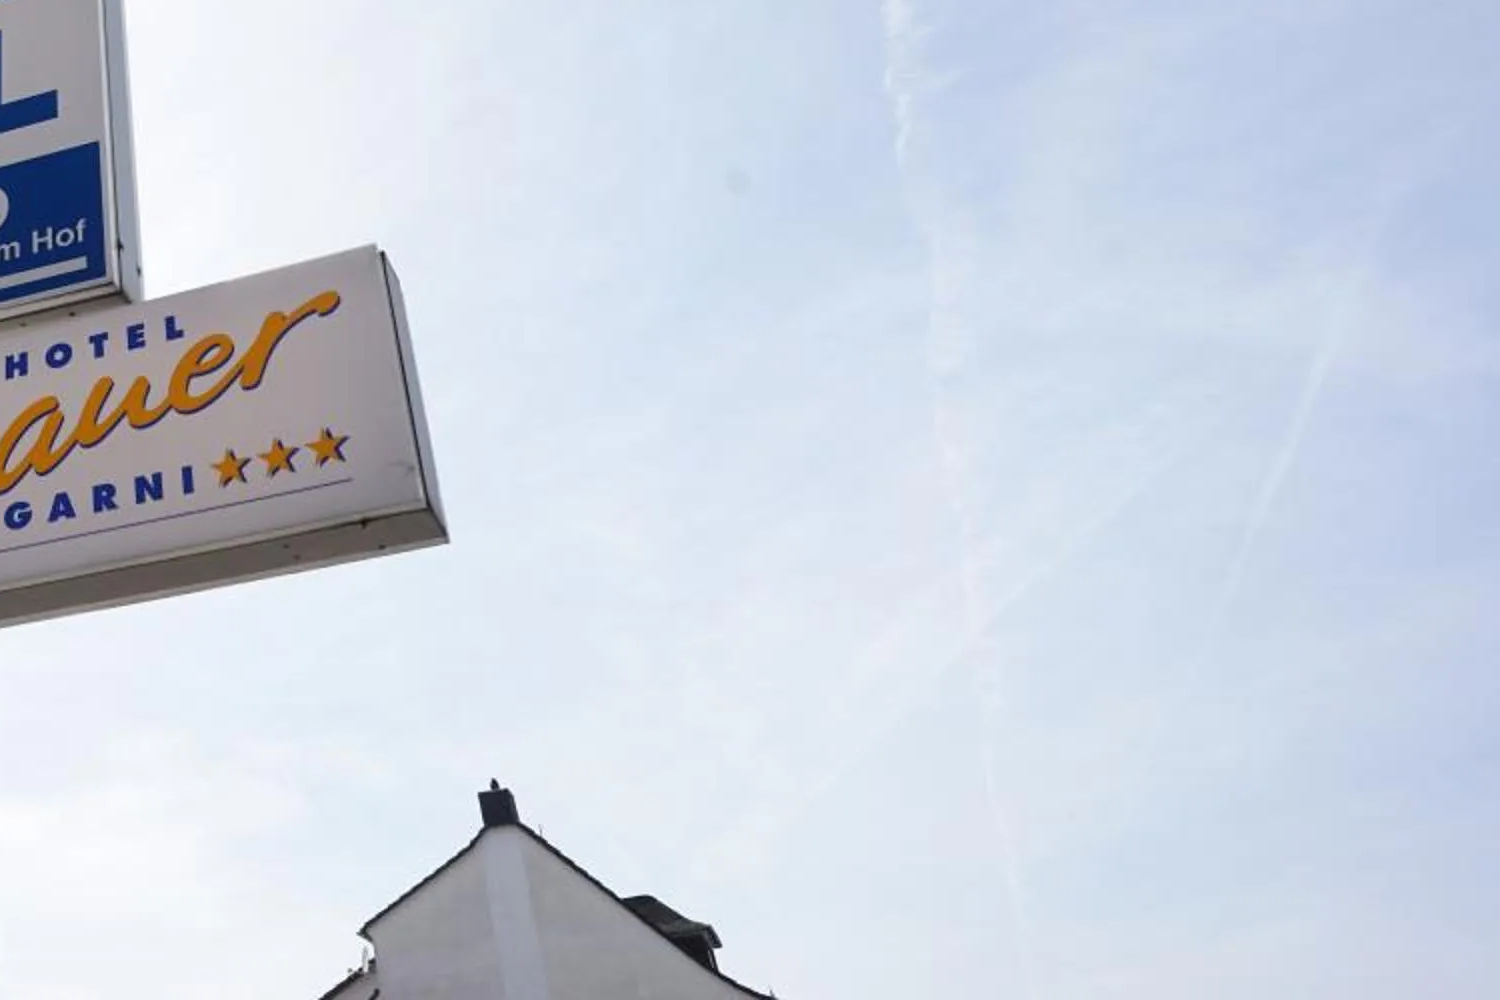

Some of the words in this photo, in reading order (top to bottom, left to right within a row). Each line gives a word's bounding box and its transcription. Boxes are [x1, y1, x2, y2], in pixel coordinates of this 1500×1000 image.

[31, 218, 87, 255] Hof
[5, 315, 185, 379] HOTEL
[3, 465, 195, 529] GARNI
